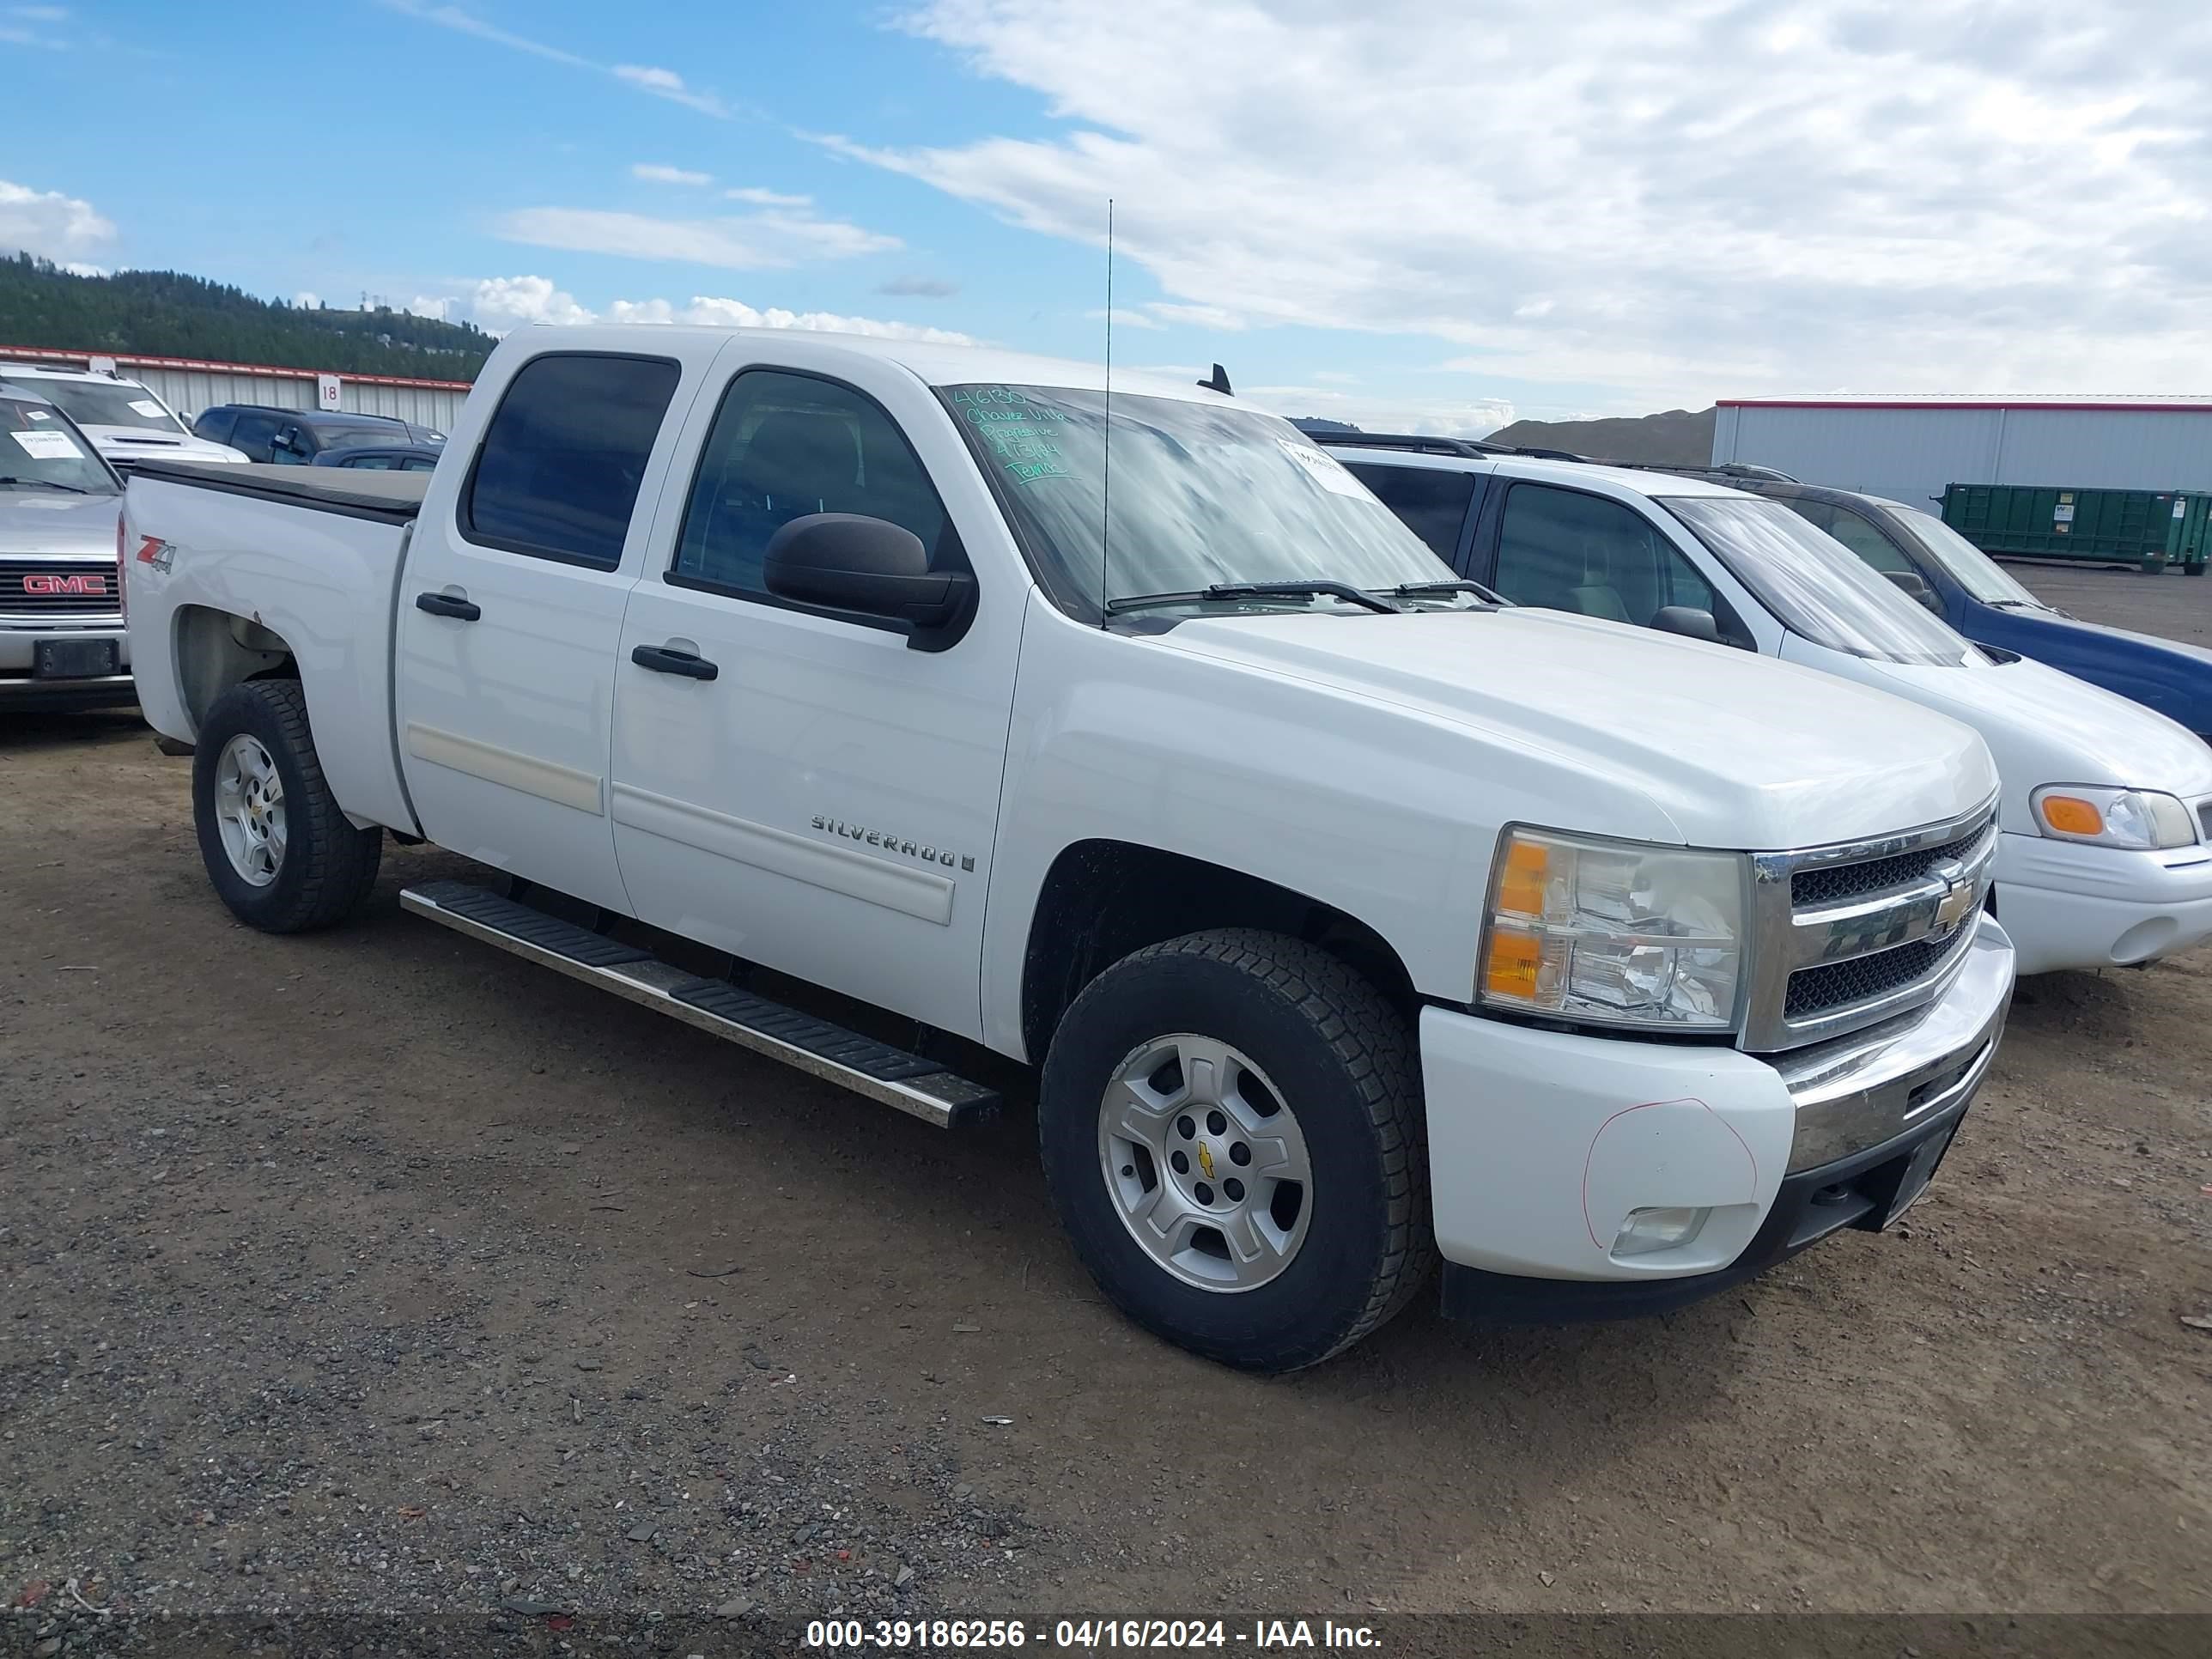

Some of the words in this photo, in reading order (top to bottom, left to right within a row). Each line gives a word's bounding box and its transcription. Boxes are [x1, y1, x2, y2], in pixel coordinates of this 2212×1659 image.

[323, 386, 337, 401] 18
[22, 575, 107, 595] GMC
[811, 813, 955, 867] SILVERADO
